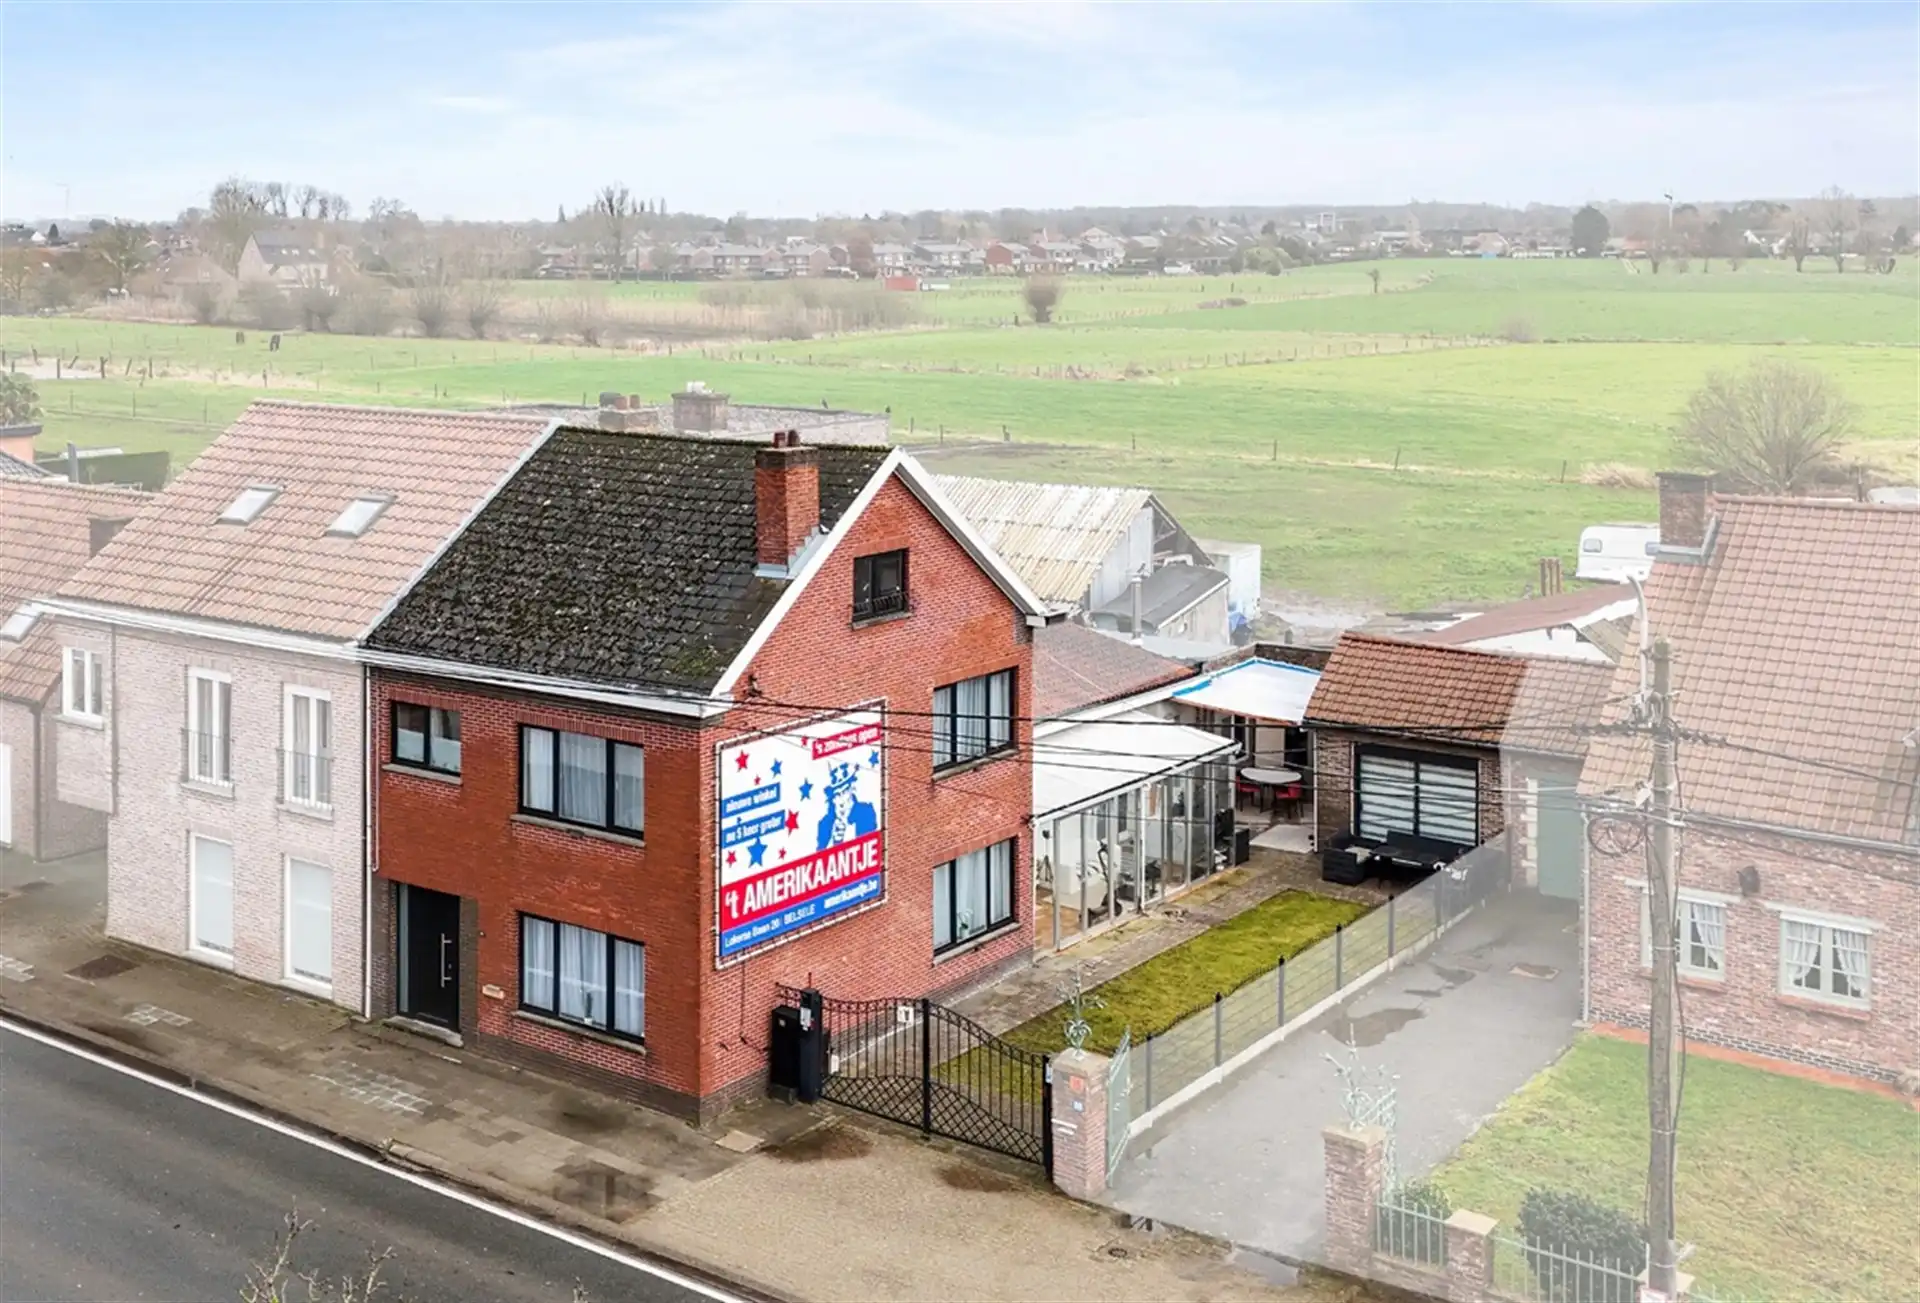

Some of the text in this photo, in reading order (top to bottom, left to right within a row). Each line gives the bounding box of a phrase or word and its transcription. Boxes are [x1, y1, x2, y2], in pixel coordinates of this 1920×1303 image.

[743, 839, 878, 915] AMERIKAANTJE
[752, 924, 770, 937] Baan
[783, 903, 816, 925] BELSELE
[824, 879, 878, 909] amerikaantje.be
